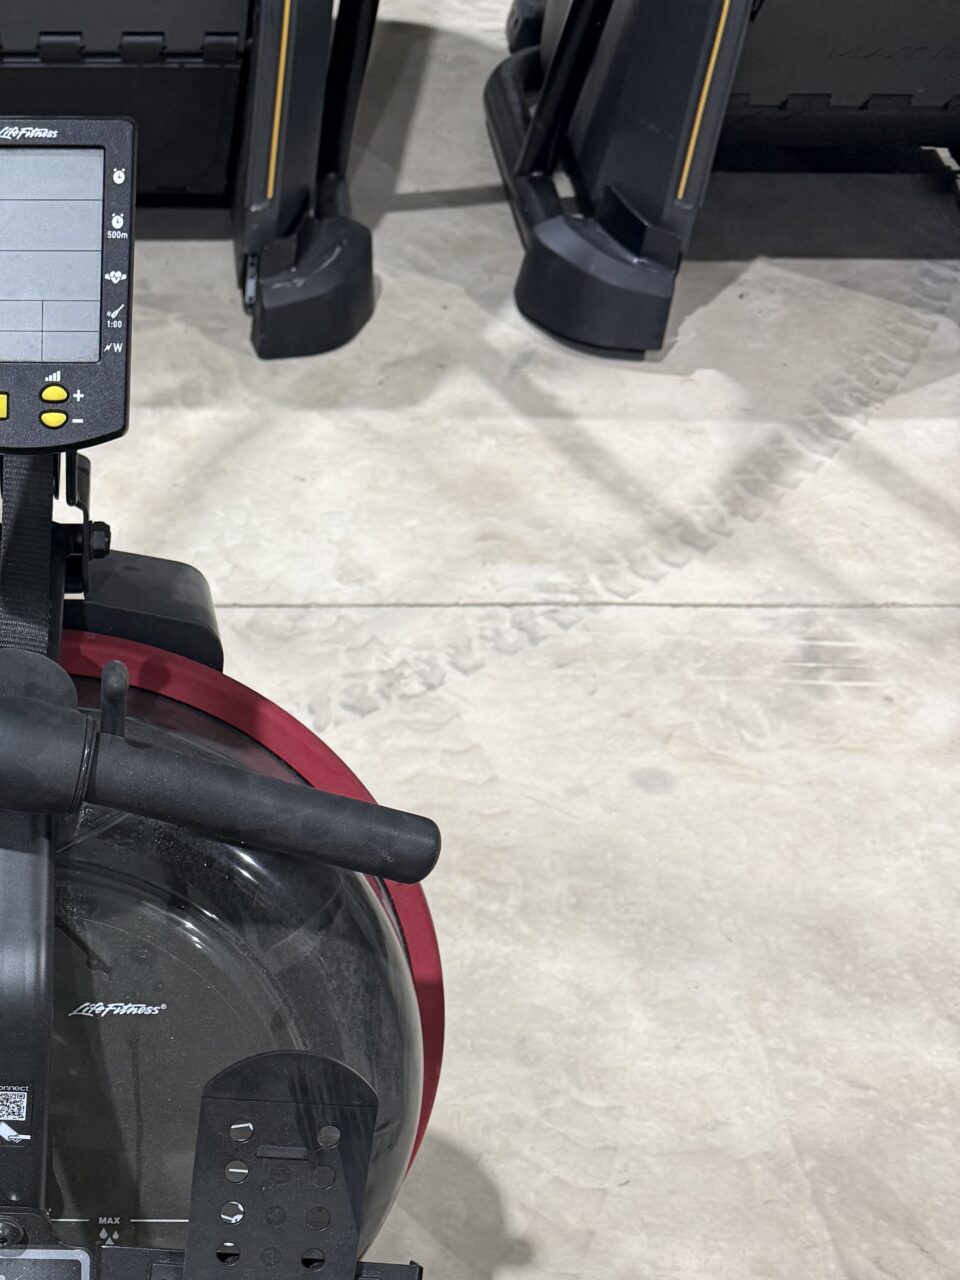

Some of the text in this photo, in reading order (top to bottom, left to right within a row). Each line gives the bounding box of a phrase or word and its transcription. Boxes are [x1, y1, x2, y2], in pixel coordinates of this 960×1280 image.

[107, 231, 128, 239] 500m
[106, 320, 122, 328] 1:00
[98, 1216, 120, 1225] MAX
